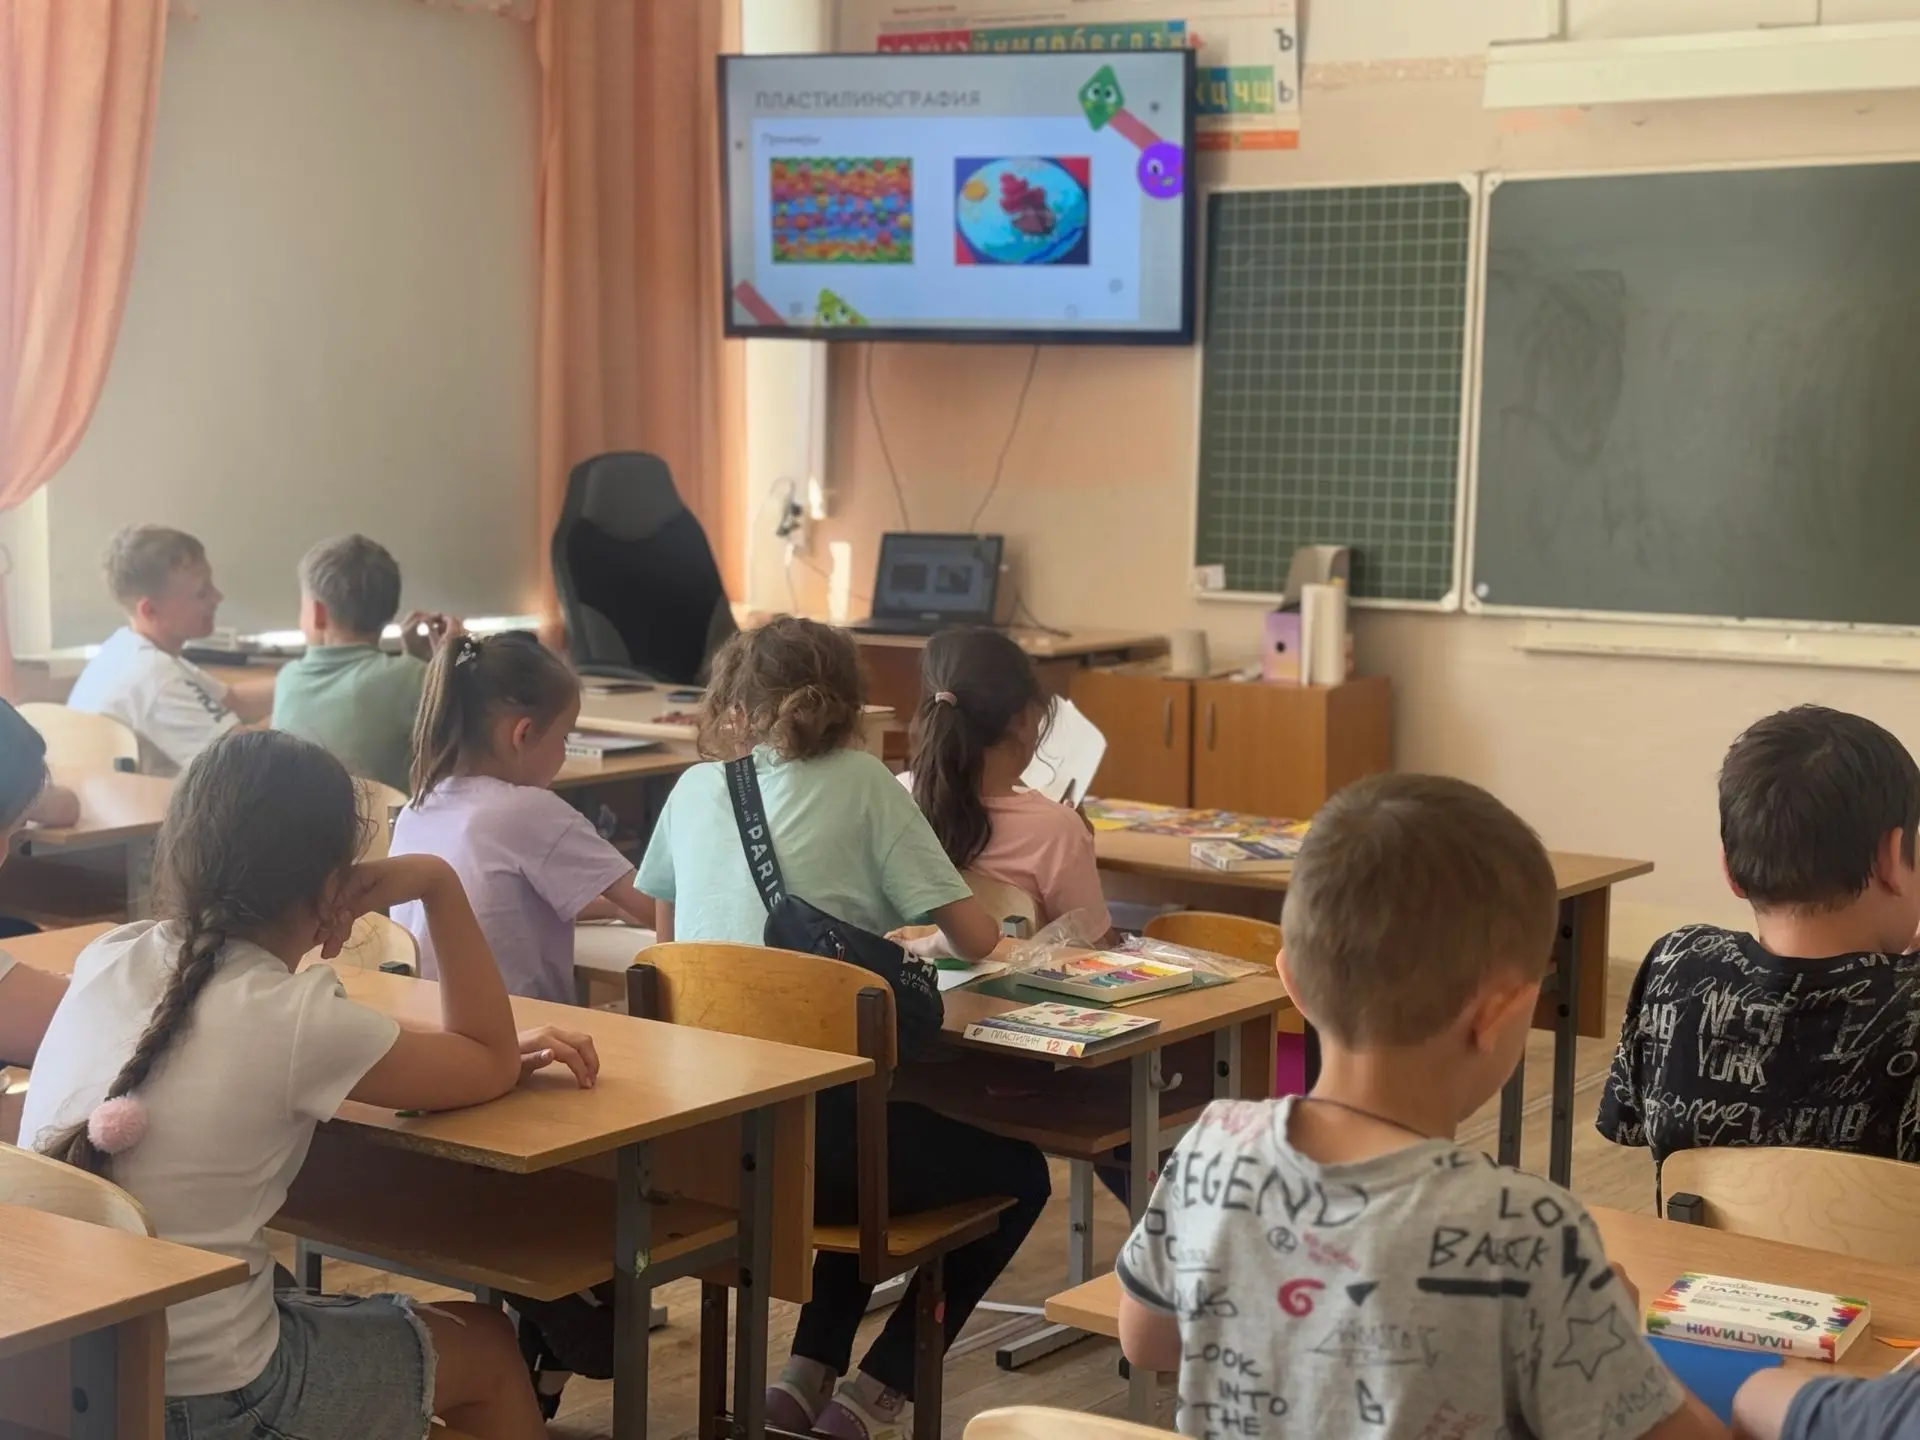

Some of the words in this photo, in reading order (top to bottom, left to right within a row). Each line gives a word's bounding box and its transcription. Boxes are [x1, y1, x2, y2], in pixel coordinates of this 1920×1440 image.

[755, 90, 982, 110] ПЛАСТИЛИНОГРАФИЯ
[747, 823, 784, 908] PARIS
[990, 1030, 1040, 1048] ПЛАСТИЛИН
[1686, 1322, 1793, 1350] ПЛАСТИЛИН
[1185, 1342, 1262, 1378] LOOK
[1219, 1379, 1288, 1417] INTO
[1192, 1402, 1261, 1436] THE
